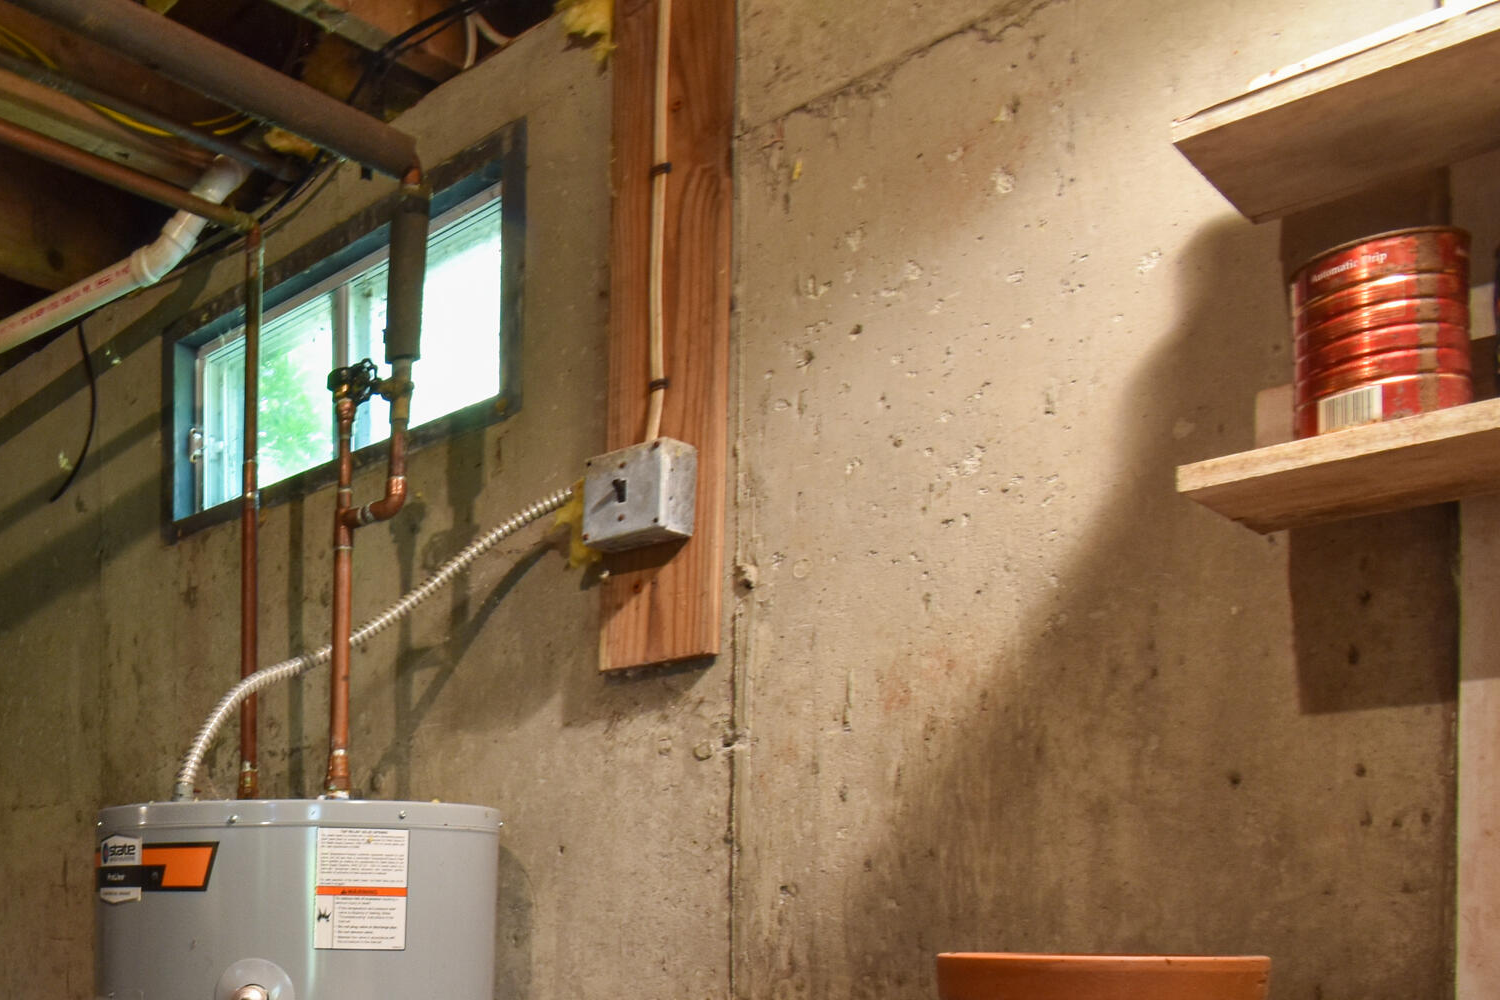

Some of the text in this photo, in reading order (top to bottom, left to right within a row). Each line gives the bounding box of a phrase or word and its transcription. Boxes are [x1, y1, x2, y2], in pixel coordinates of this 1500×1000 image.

[1311, 252, 1388, 283] Automatic Drip
[109, 843, 136, 856] state
